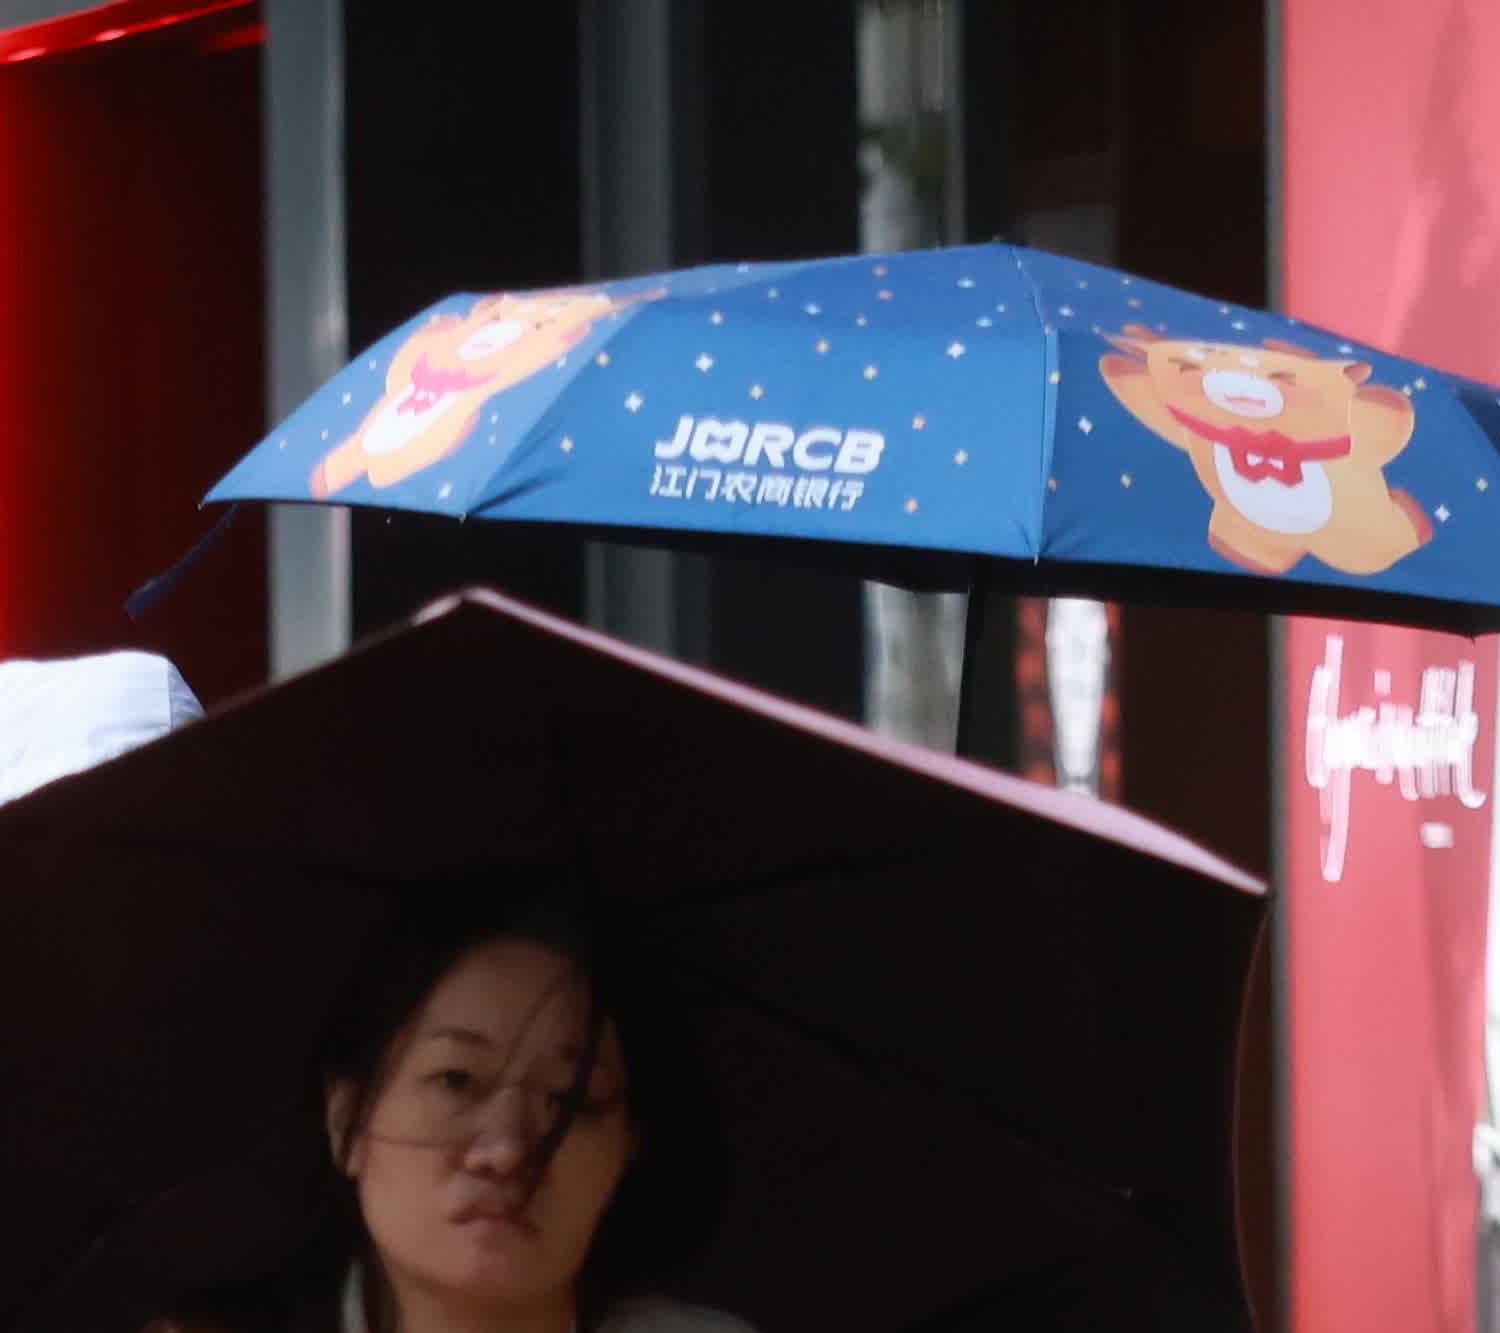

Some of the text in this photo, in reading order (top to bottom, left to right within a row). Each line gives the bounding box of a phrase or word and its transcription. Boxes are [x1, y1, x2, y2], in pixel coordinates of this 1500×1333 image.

[648, 463, 866, 511] 江门农商银行
